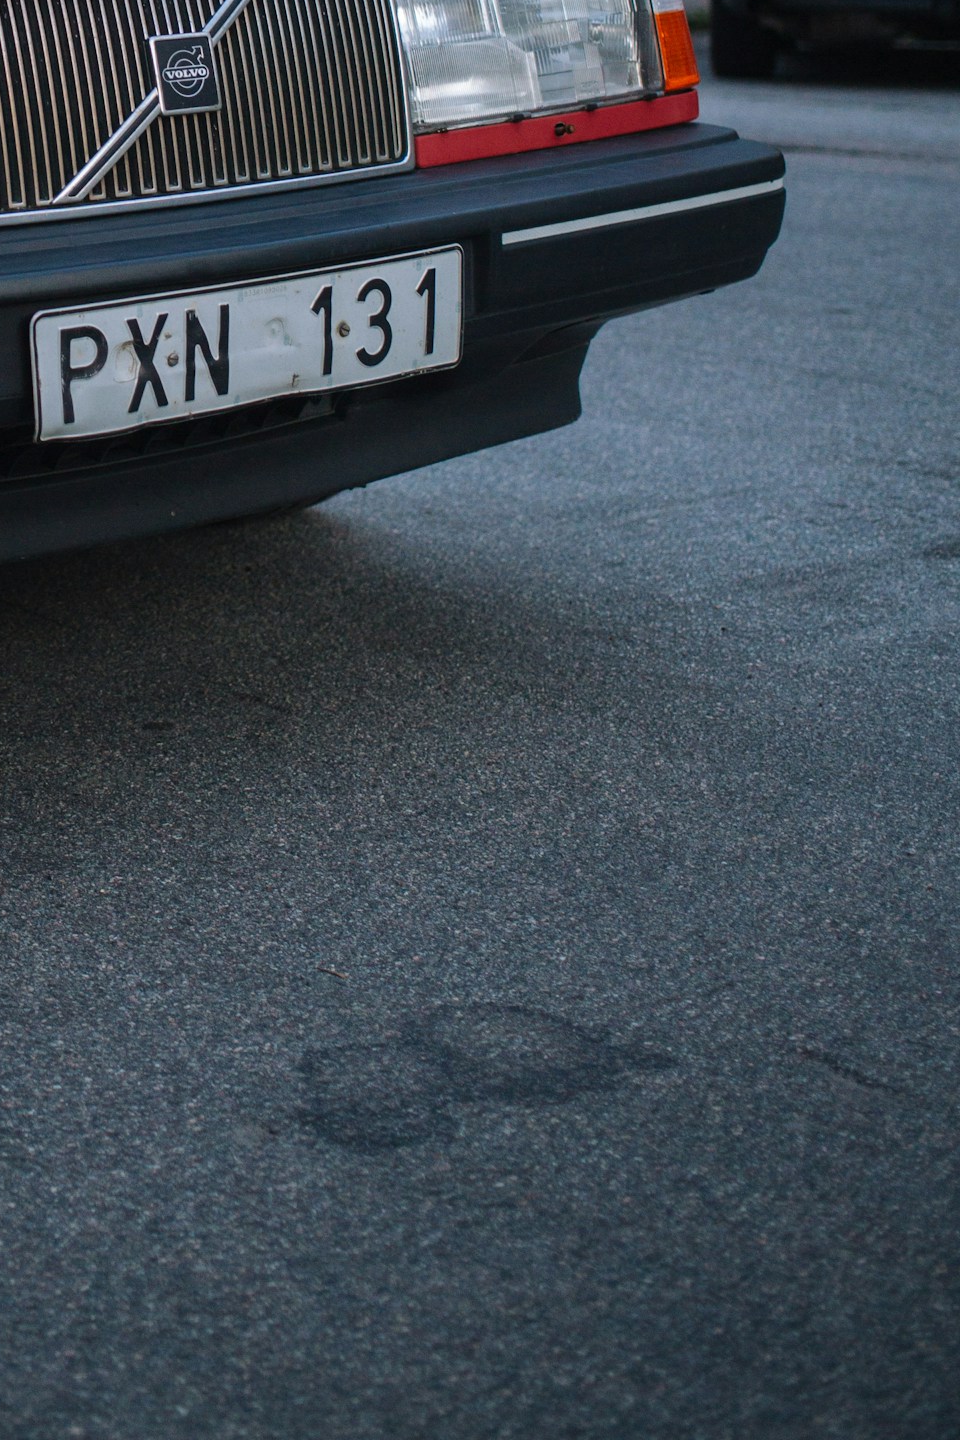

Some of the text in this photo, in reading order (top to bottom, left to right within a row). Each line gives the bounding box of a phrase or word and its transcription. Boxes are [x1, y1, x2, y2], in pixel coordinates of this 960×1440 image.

[165, 67, 207, 80] VOLVO
[59, 267, 437, 425] PXN 131
